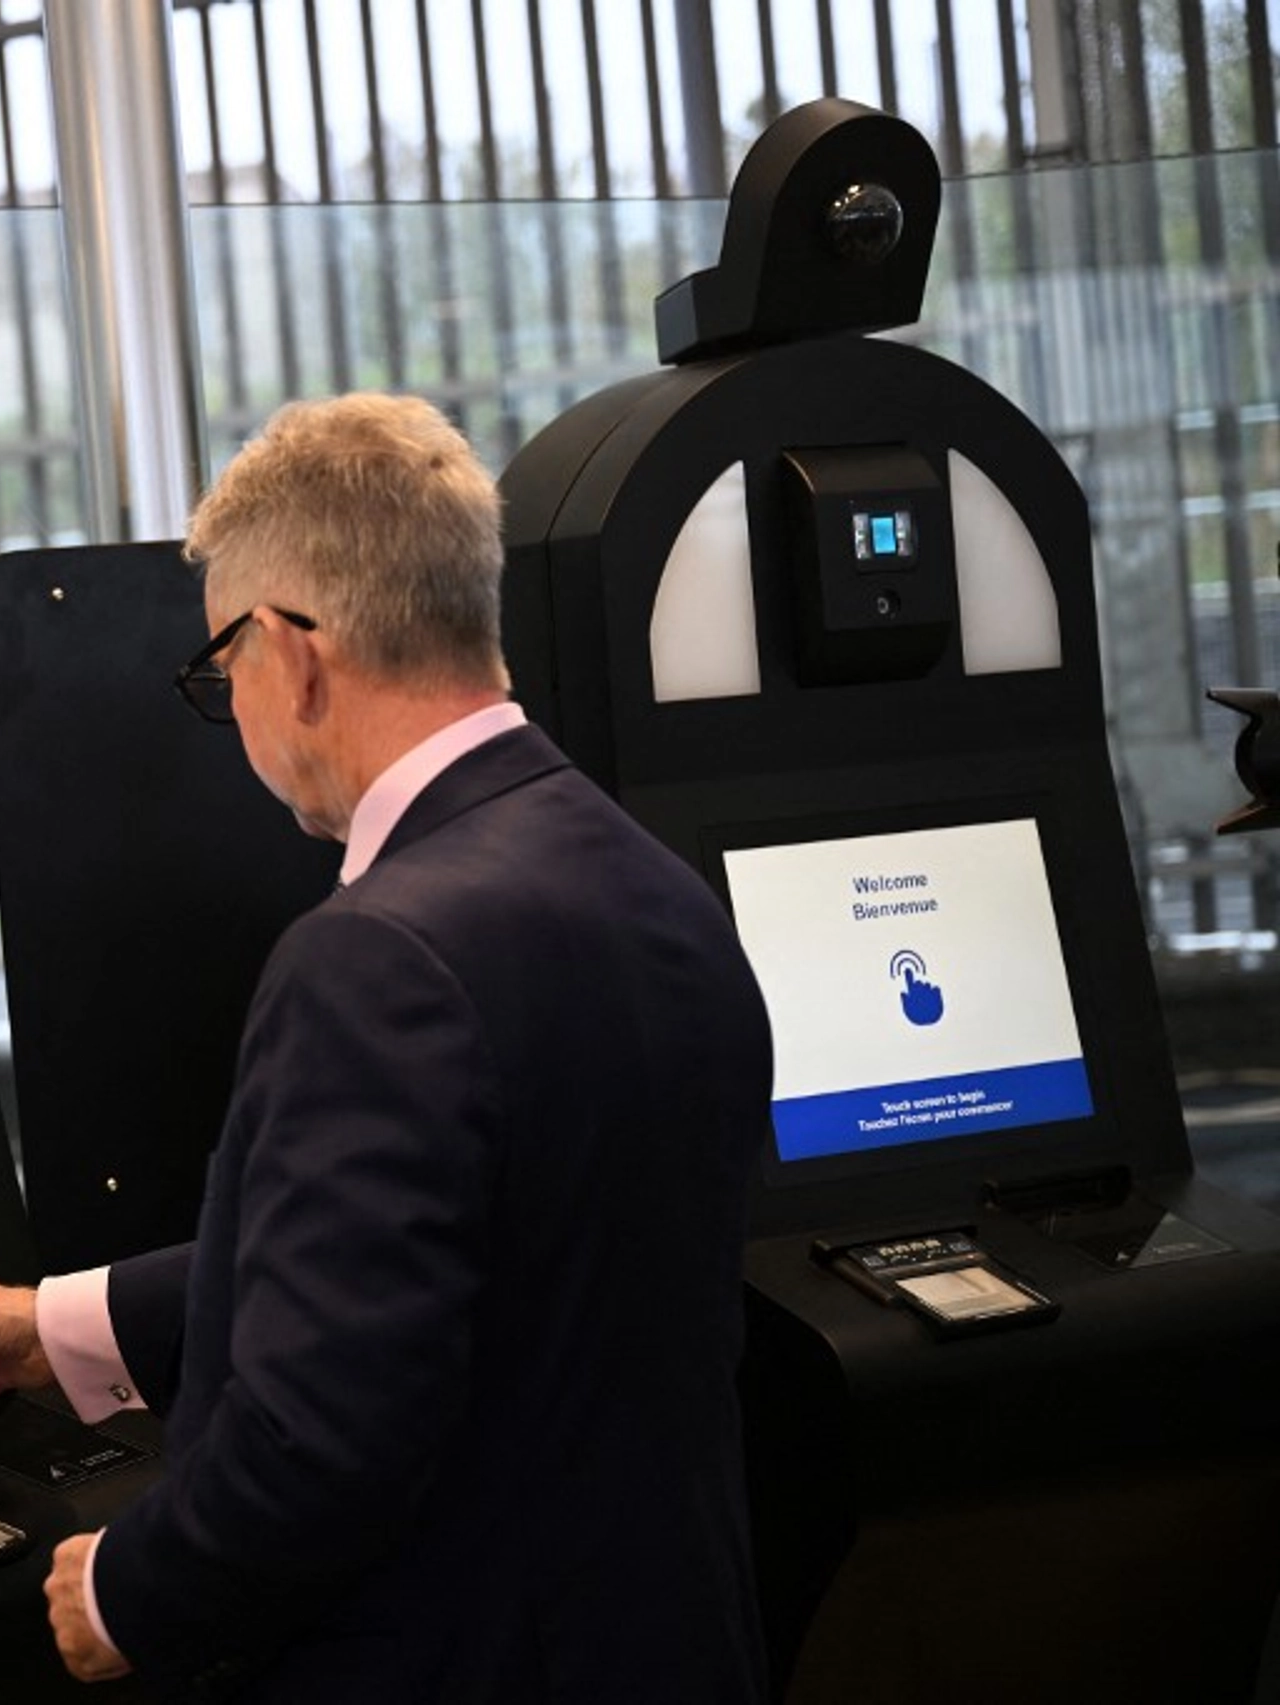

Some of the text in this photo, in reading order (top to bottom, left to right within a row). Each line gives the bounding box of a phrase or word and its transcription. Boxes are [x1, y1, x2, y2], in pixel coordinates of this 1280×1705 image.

[852, 875, 928, 893] Welcome
[852, 899, 937, 920] Bienvenue
[881, 1090, 986, 1114] Touch screen to begin
[858, 1117, 898, 1131] Touchez
